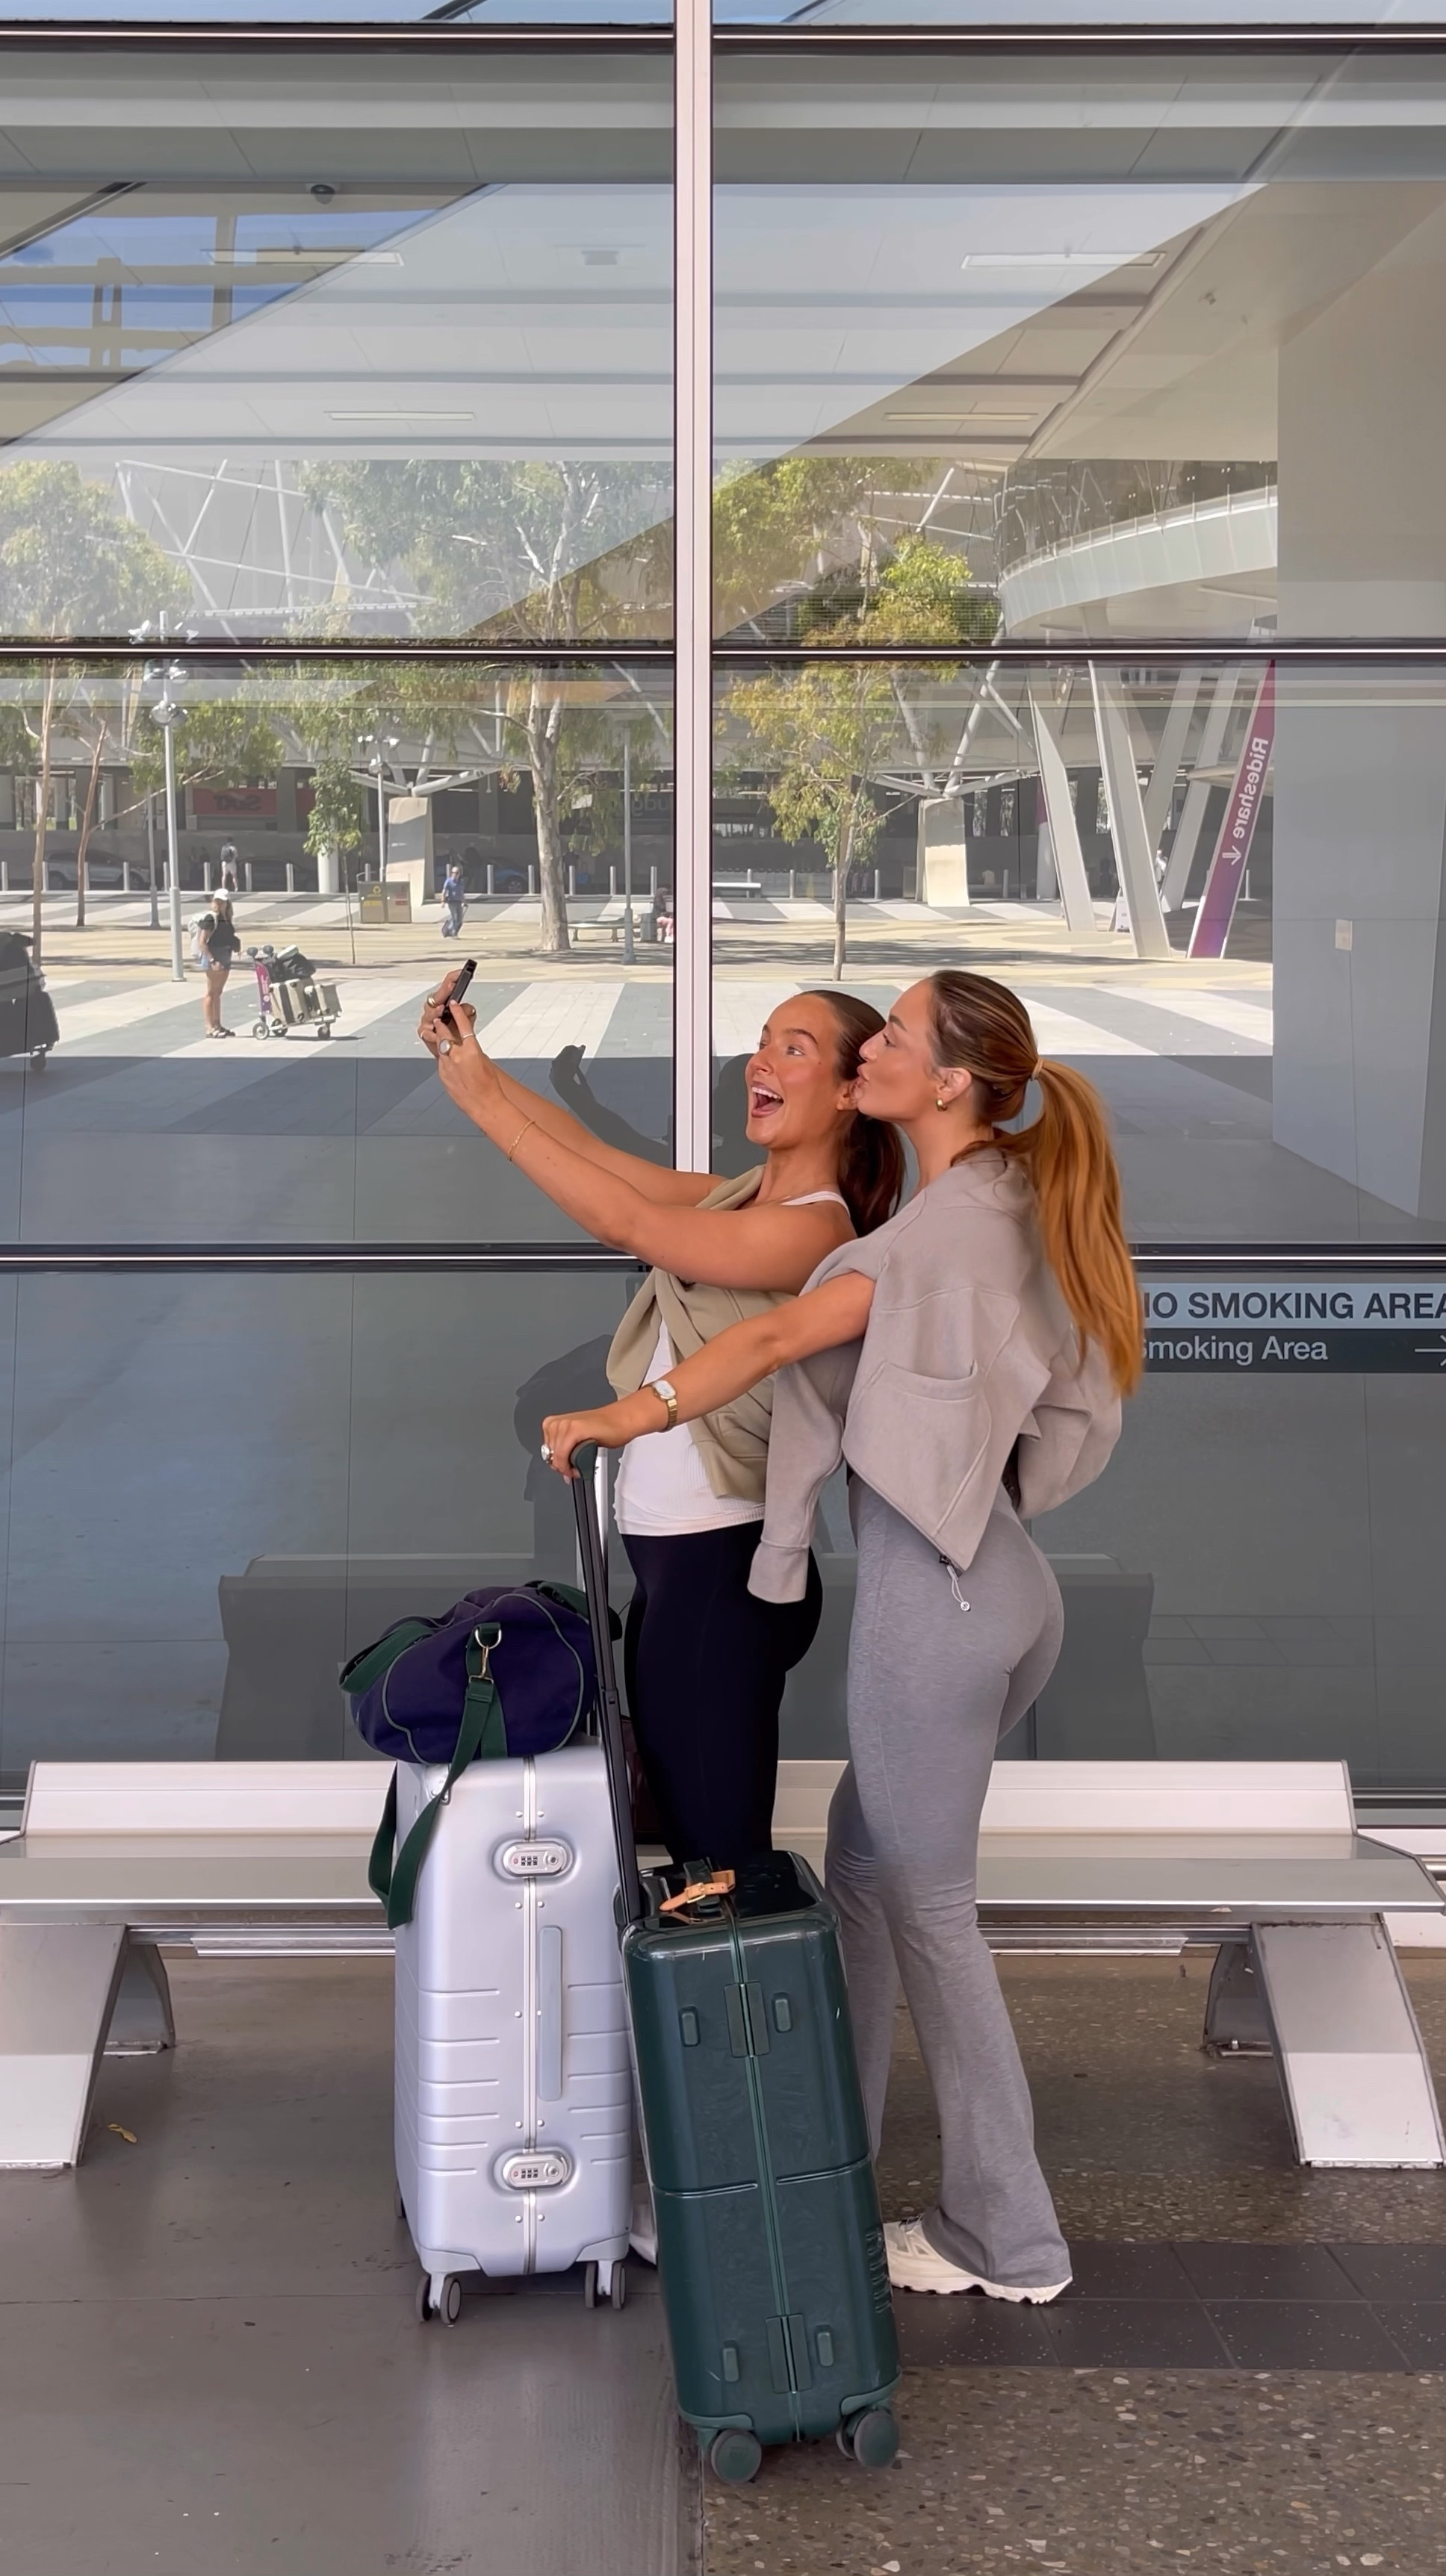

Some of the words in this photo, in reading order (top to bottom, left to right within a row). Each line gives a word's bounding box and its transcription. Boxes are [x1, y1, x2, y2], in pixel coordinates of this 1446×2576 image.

[1144, 1292, 1178, 1319] O
[1188, 1292, 1353, 1319] SMOKING
[1143, 1335, 1253, 1366] moking
[1261, 1335, 1328, 1360] Area
